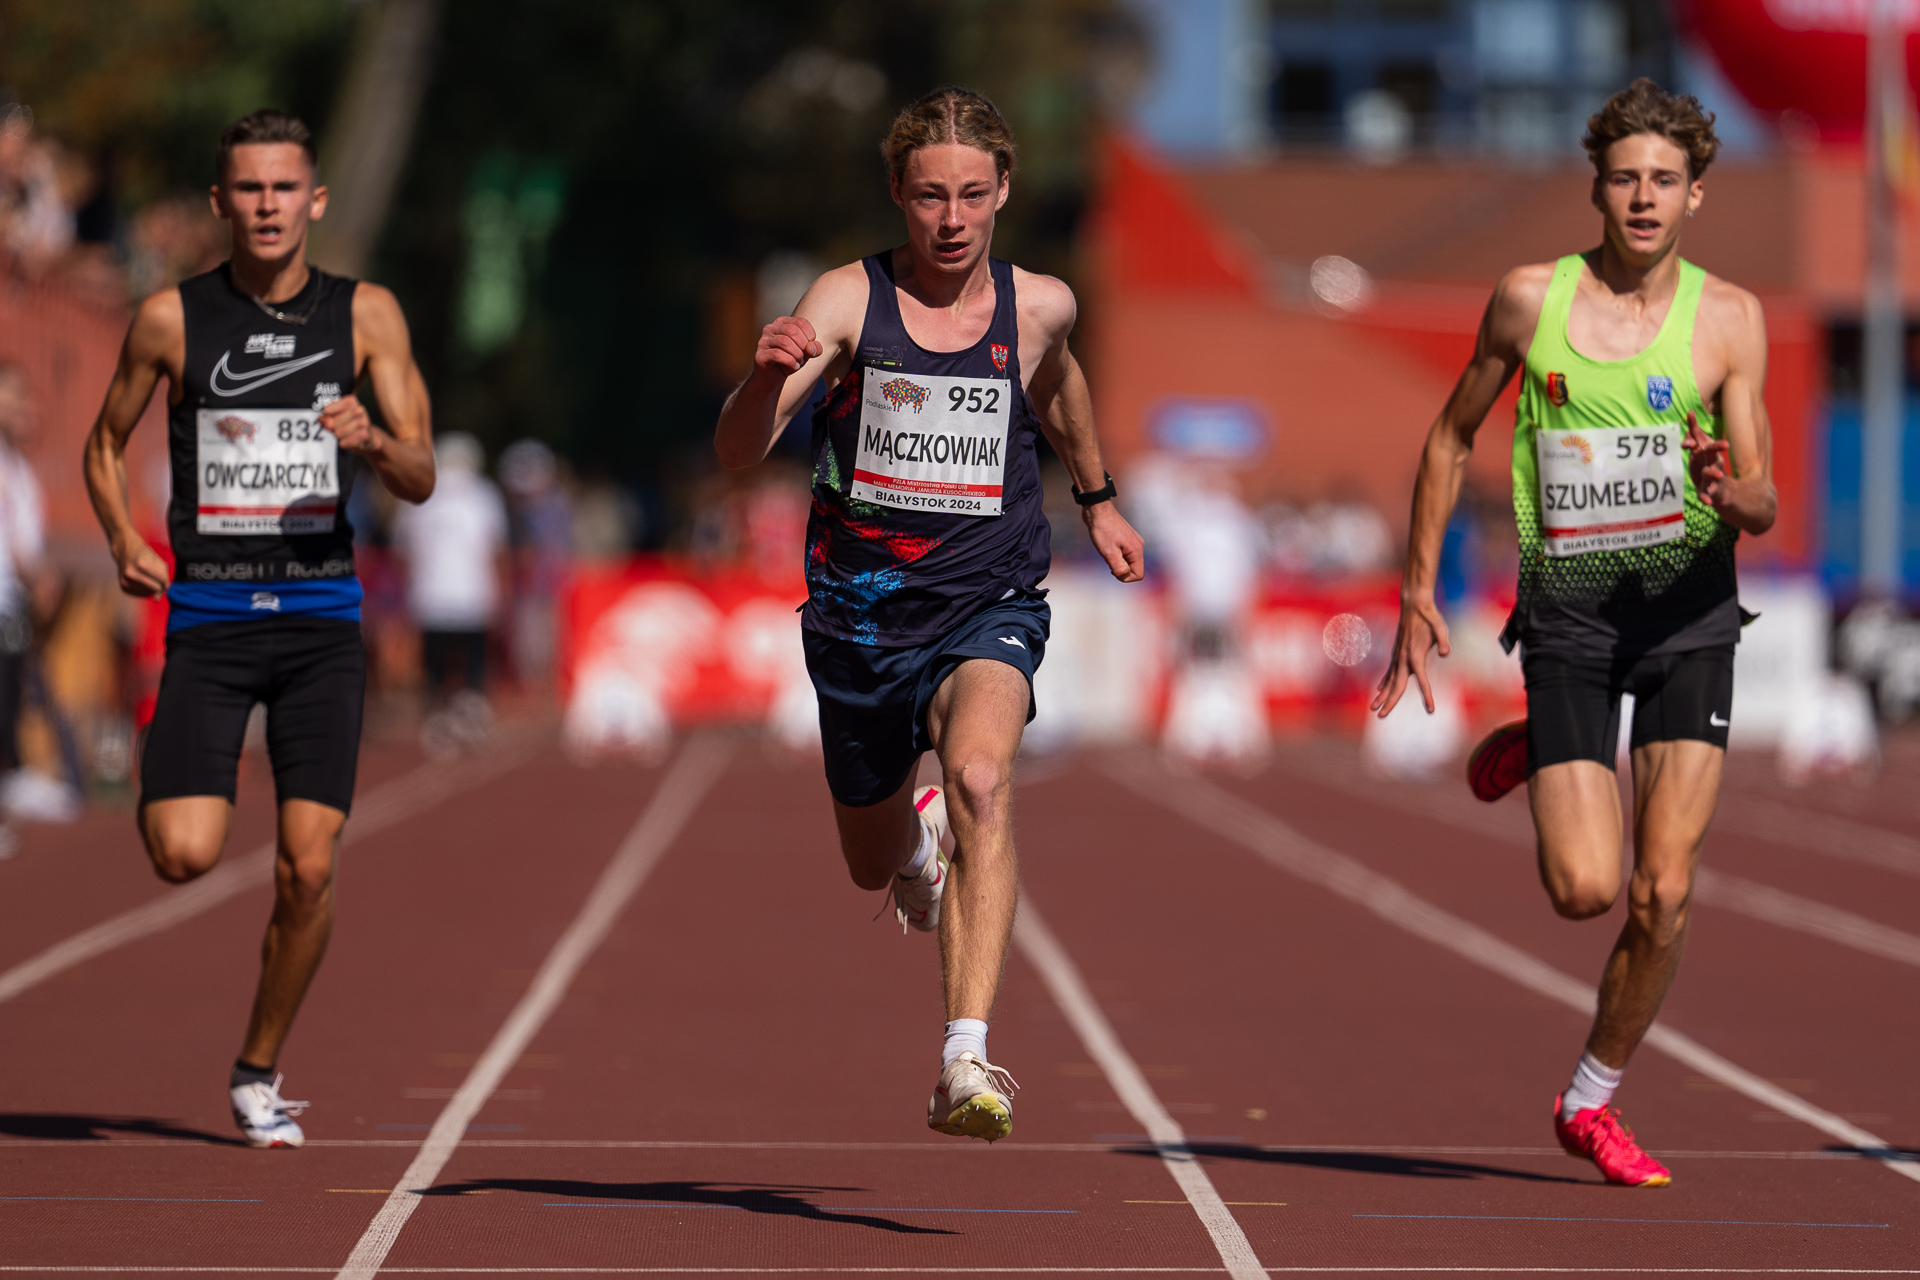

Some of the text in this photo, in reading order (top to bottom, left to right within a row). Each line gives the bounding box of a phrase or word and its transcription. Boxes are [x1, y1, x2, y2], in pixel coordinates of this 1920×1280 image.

[865, 398, 893, 412] Podlaskie
[948, 386, 1000, 413] 952
[278, 417, 325, 442] 832
[864, 424, 1002, 466] MĄCZKOWIAK
[1616, 434, 1668, 459] 578
[205, 461, 331, 489] OWCZARCZYK
[892, 478, 906, 486] PZLA
[906, 480, 940, 489] Mistrzostwa
[875, 491, 981, 511] BIAŁYSTOK 2024
[1545, 476, 1676, 510] SZUMEŁDA
[1562, 530, 1662, 551] BIAŁYSTOK 2024
[186, 562, 264, 580] ROUGH
